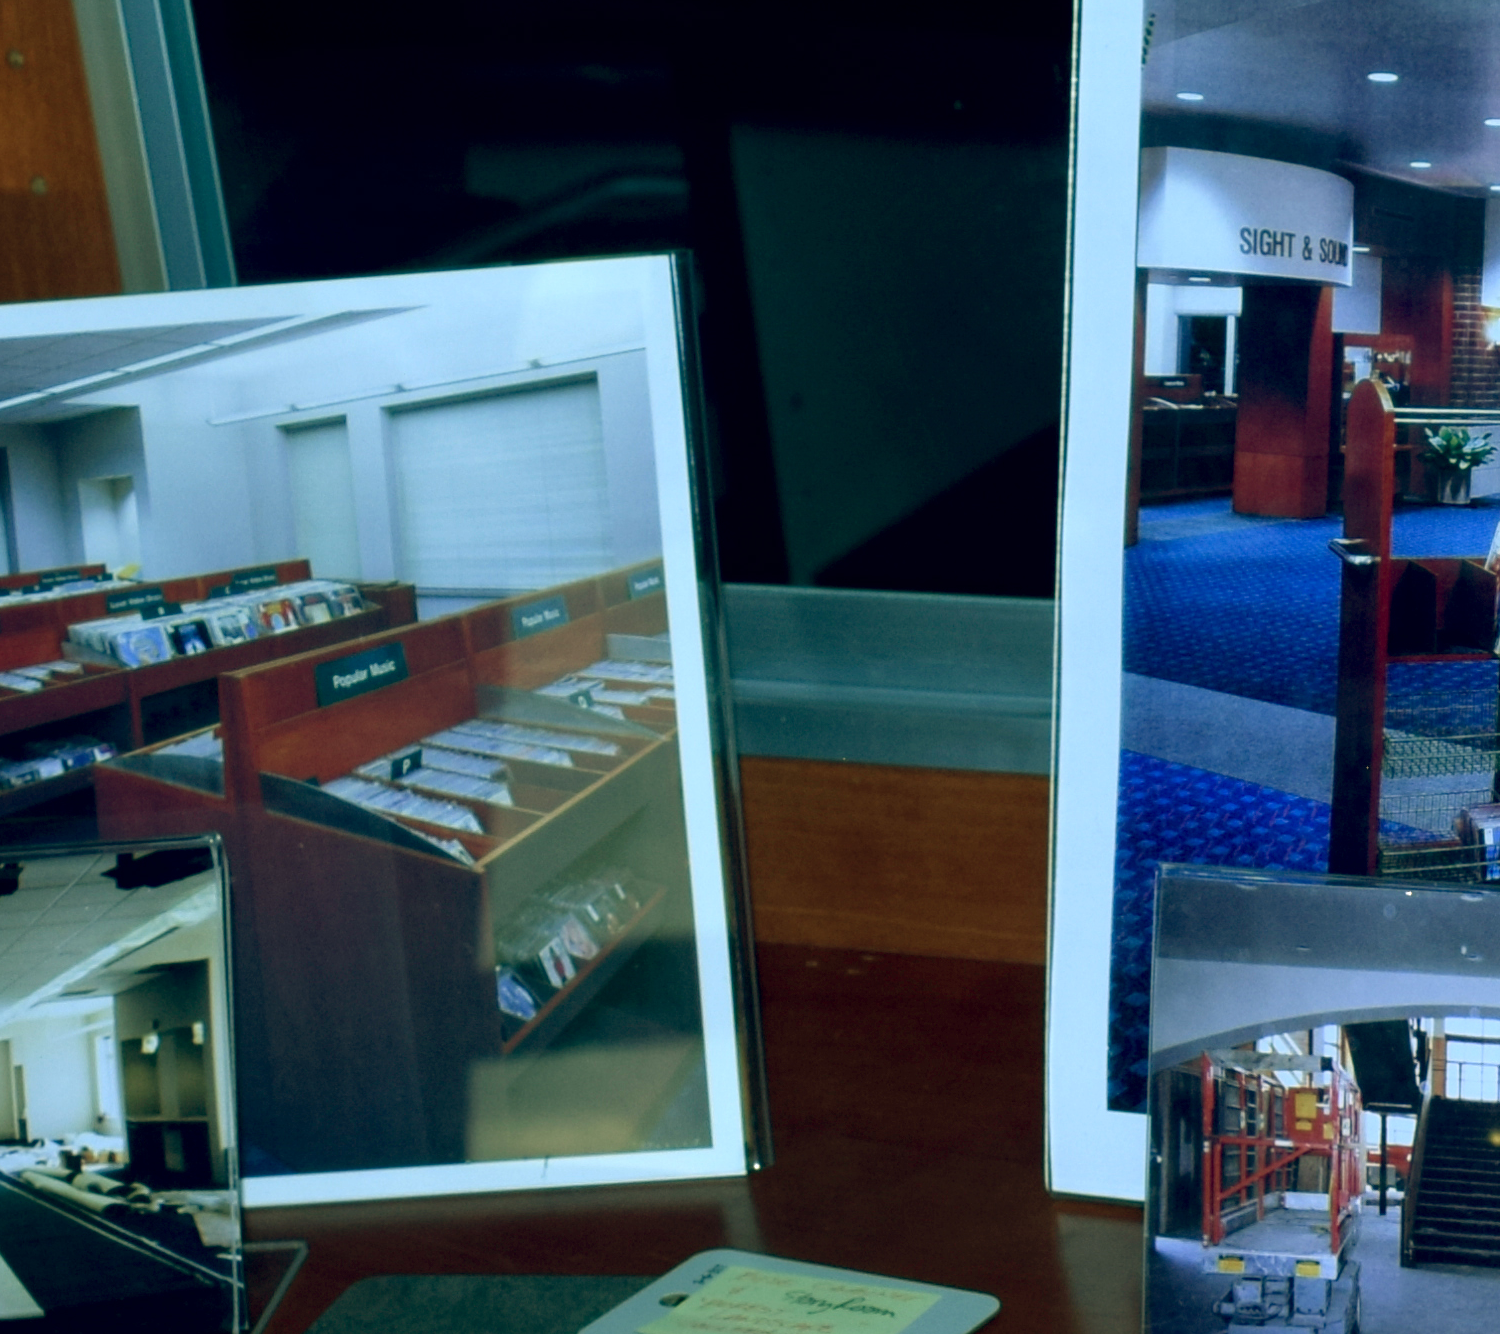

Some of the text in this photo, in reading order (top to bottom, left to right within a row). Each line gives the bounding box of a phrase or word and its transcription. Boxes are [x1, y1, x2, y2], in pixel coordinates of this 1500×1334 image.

[1239, 226, 1296, 259] SIGHT
[1302, 234, 1313, 261] &
[332, 659, 396, 689] Popular Music
